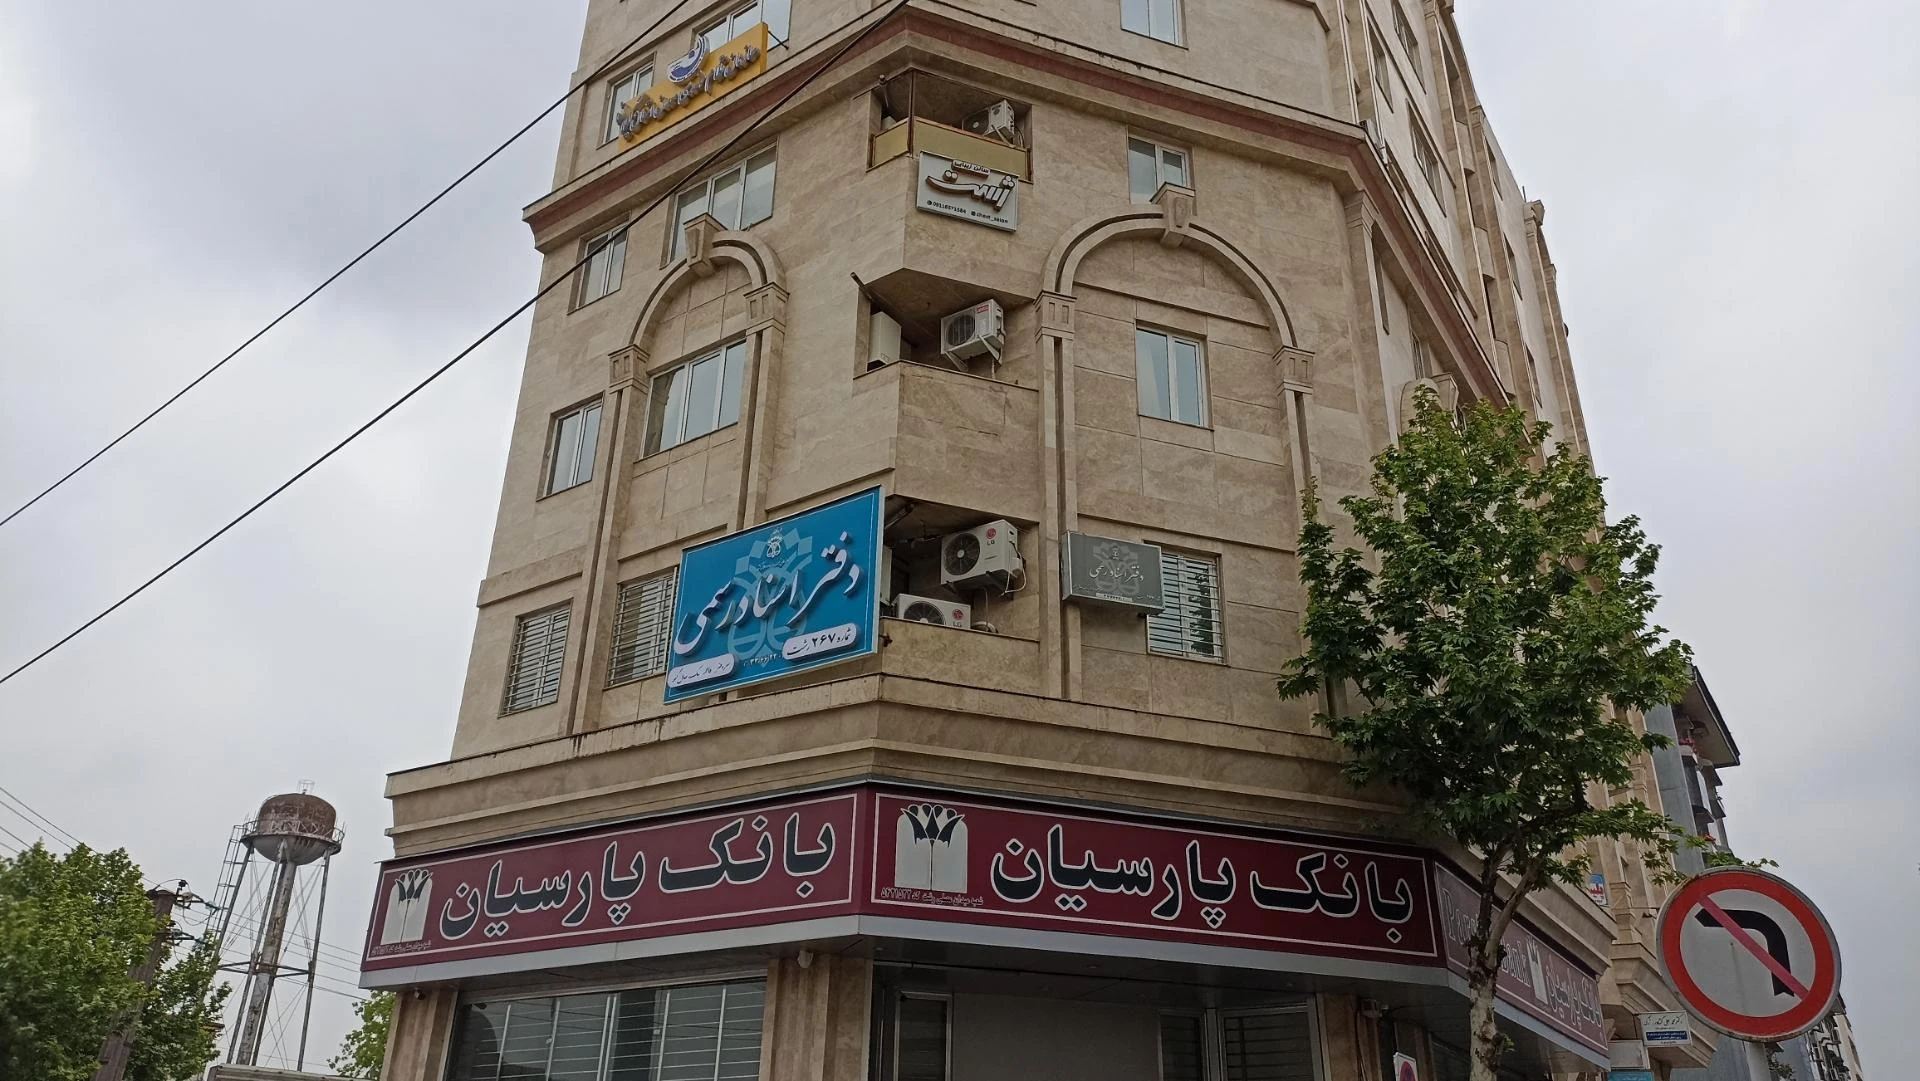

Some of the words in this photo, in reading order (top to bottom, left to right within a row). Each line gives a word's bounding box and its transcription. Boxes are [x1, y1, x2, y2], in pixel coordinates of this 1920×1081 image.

[674, 579, 736, 655] رسمی
[733, 568, 800, 626] اسناد
[786, 531, 861, 628] دفتر
[811, 633, 836, 647] ۲۶۷
[439, 840, 647, 941] پارسیان
[657, 811, 836, 899] بانک
[990, 823, 1236, 929] پارسیان
[1250, 851, 1413, 944] بانک
